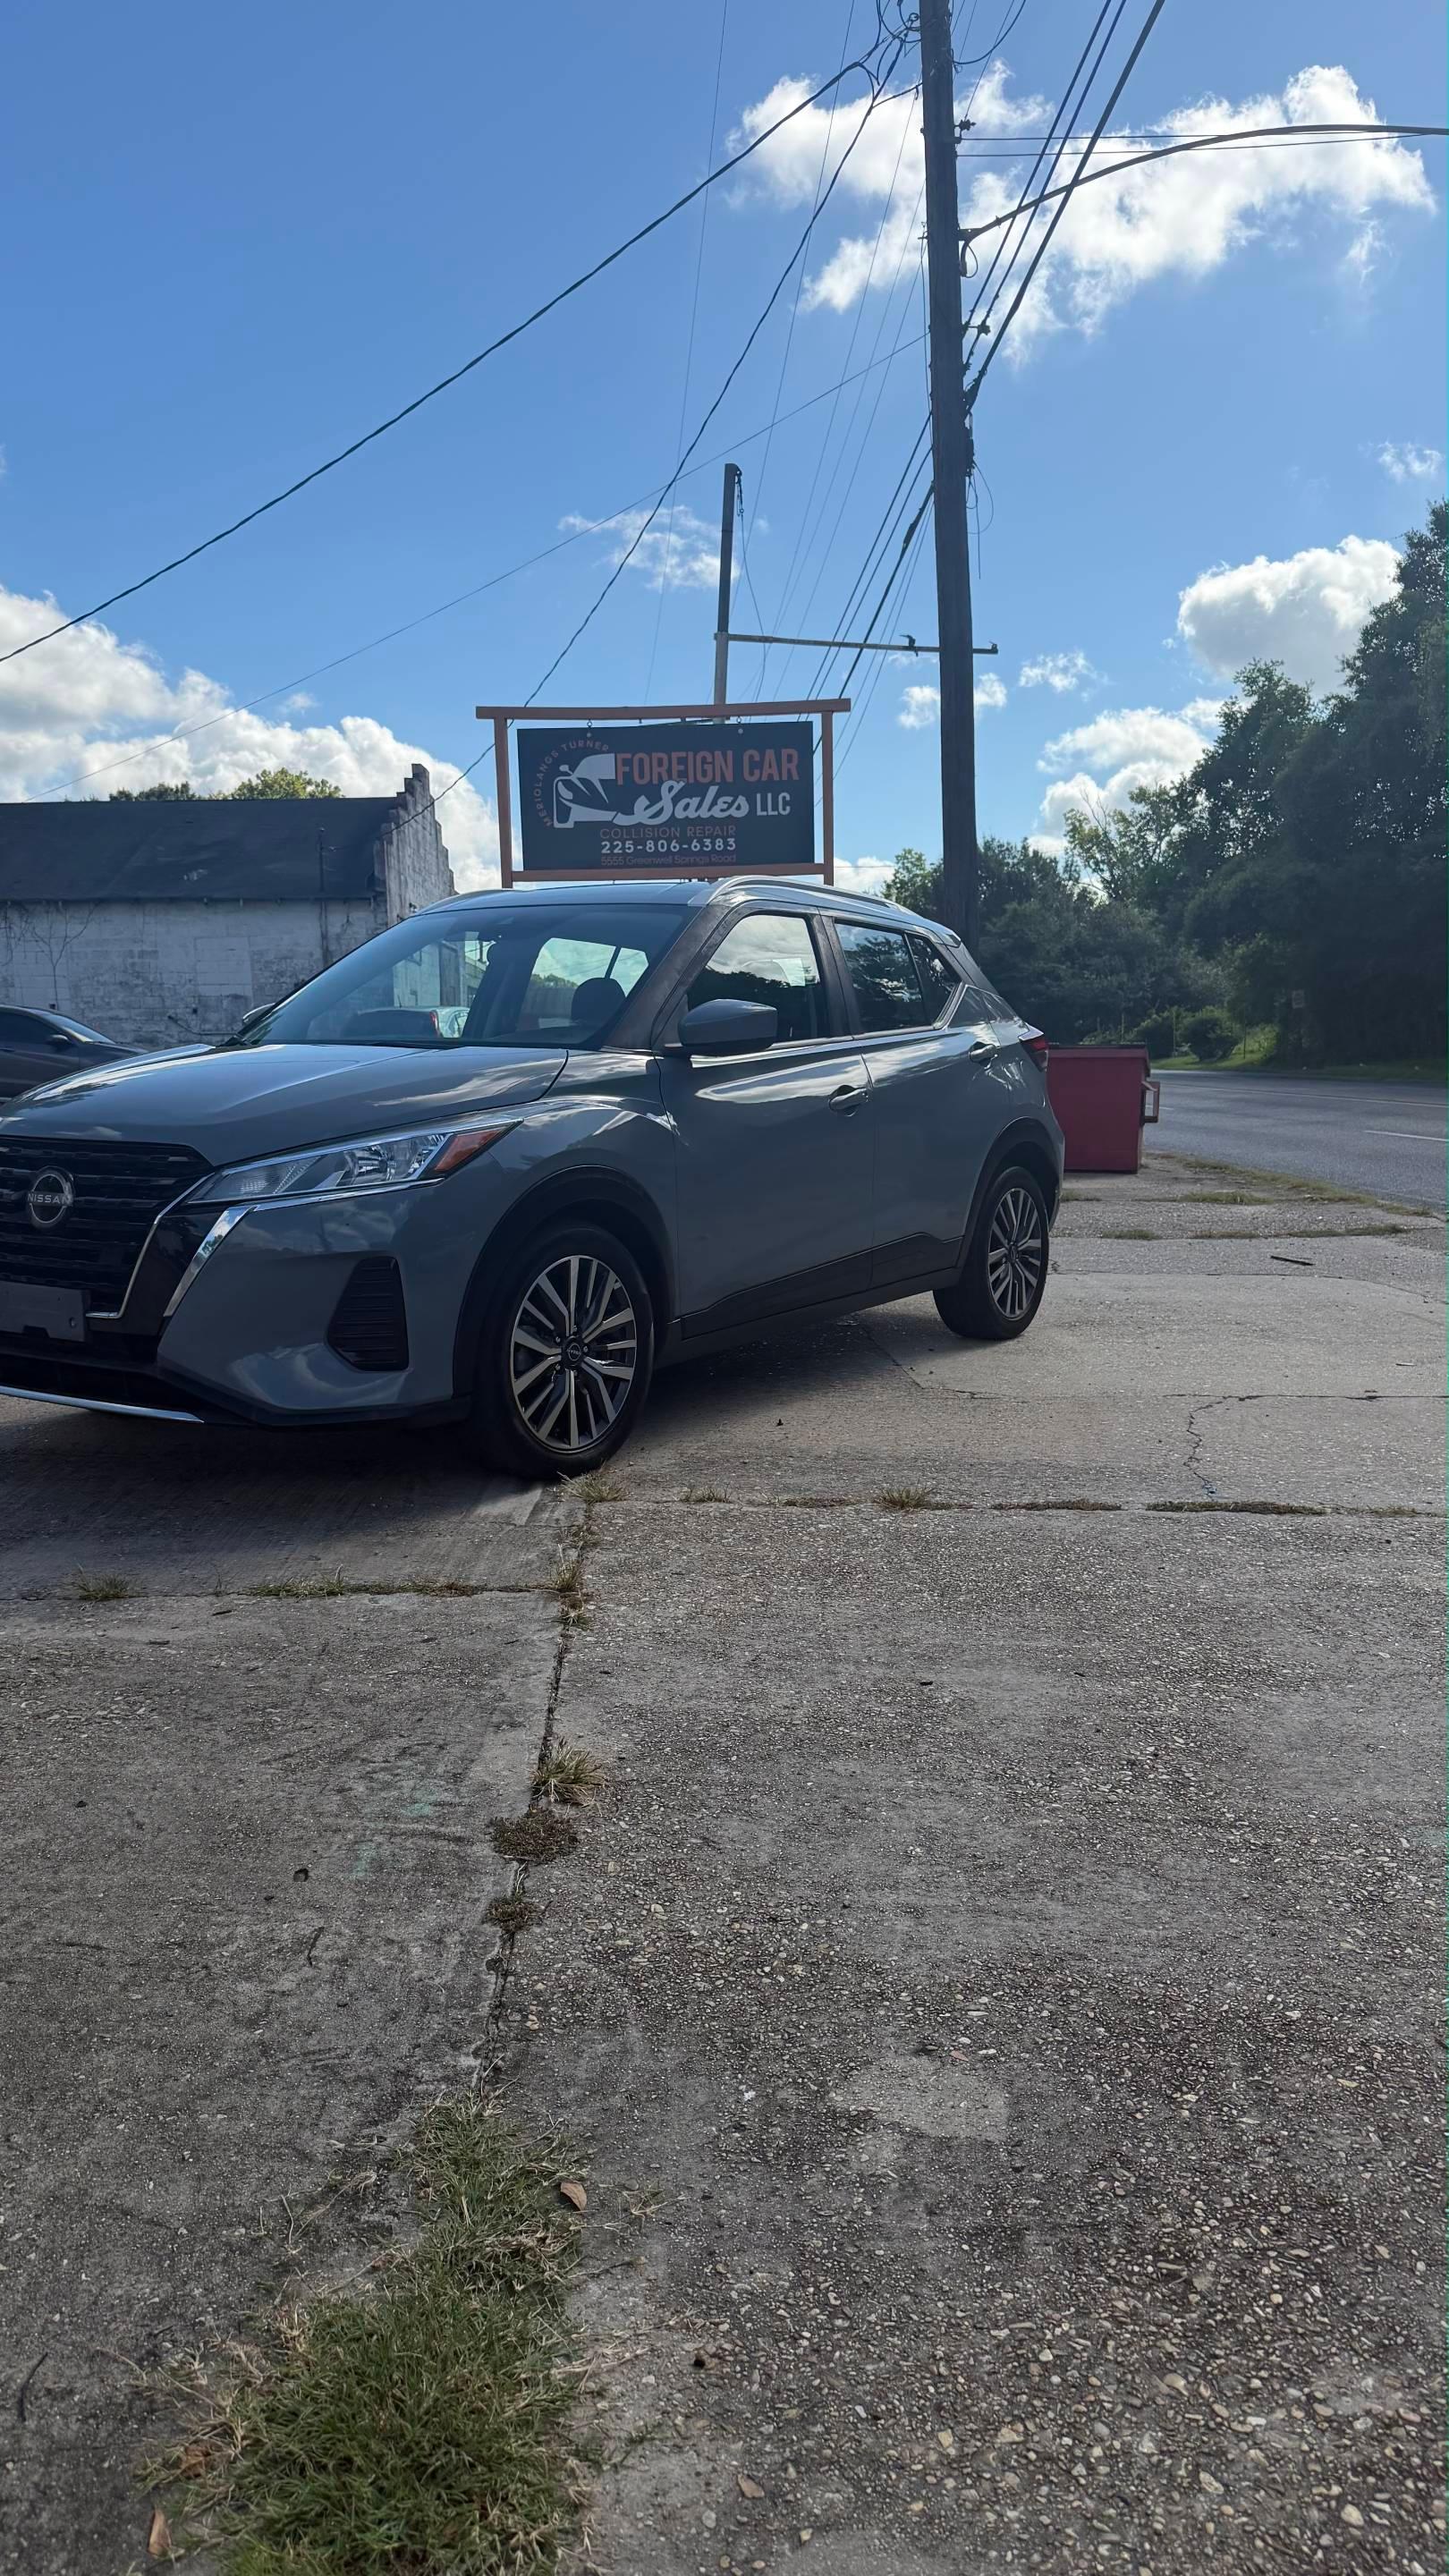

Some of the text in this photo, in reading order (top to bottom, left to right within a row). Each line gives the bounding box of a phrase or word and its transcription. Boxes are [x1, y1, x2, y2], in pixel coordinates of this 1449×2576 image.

[560, 740, 609, 752] TURNER
[616, 748, 800, 786] FOREIGN CAR
[614, 780, 791, 826] Sales LLC
[600, 825, 736, 839] COLLISION REPAIR
[600, 838, 736, 854] 225-806-6383
[600, 853, 736, 866] 5555 Greenwell Springs Road
[28, 1193, 72, 1205] NISSAN
